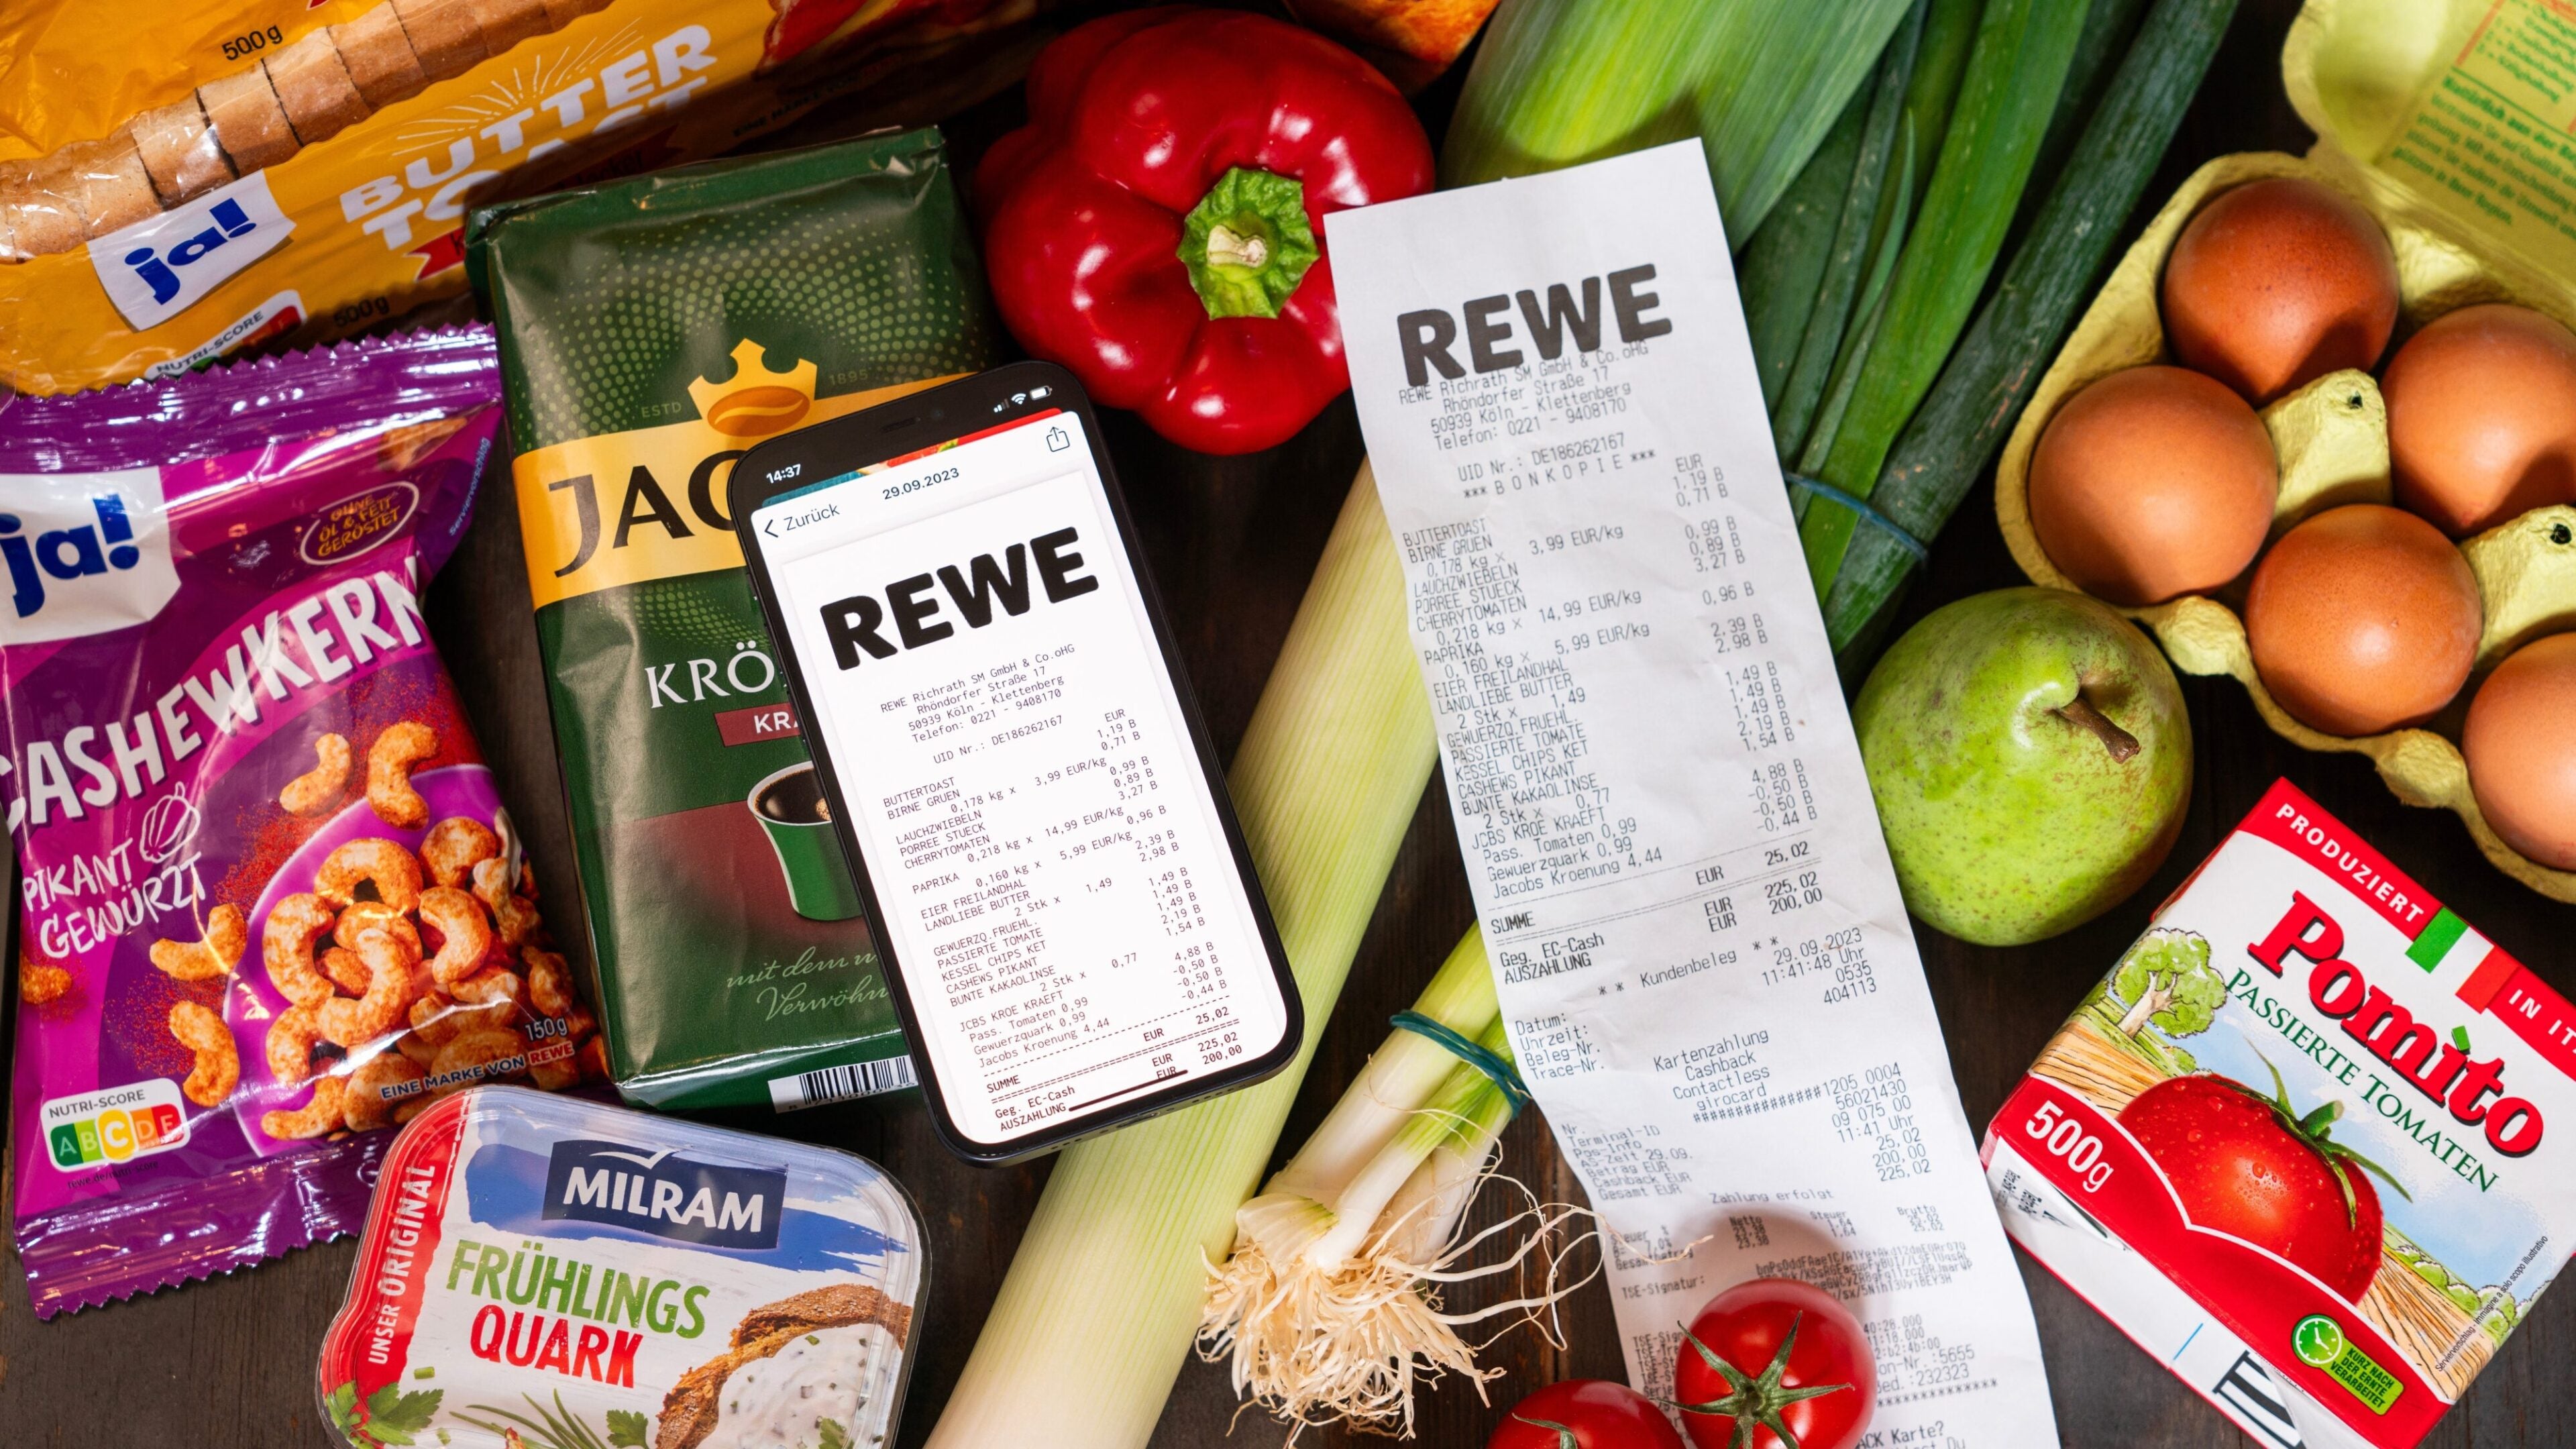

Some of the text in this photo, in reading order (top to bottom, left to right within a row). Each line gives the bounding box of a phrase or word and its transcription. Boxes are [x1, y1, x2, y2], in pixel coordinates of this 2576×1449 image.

[339, 24, 718, 223] BUTTER
[125, 198, 256, 305] ja!
[156, 310, 264, 372] NUTRI-SCORE
[1397, 263, 1673, 388] REWE
[828, 368, 869, 387] 1895
[1440, 372, 1507, 396] Richrath
[1443, 373, 1584, 413] Rhöndorfer Straße
[641, 401, 682, 419] ESTD
[1431, 382, 1631, 433] 50939 Klettenberg
[1434, 397, 1626, 450] Telefon: 9408170
[1531, 432, 1623, 465] DE186262167
[766, 464, 802, 484] 14:37
[881, 468, 961, 500] 29.09.2023
[318, 506, 400, 557] GERÖSTET
[319, 525, 339, 543] ÖL
[359, 493, 398, 521] FETT
[784, 503, 841, 532] Zurück
[0, 494, 140, 619] ja!
[820, 526, 1099, 672] REWE
[1589, 590, 1641, 612] EUR/kg
[645, 640, 787, 708] KRÖ
[880, 643, 1075, 712] REWE Richrath SM GmbH Co.oHG
[916, 674, 1026, 714] Rhöndorfer Straße
[1473, 657, 1568, 690] FREILANDHAL
[753, 711, 798, 734] KR
[908, 676, 1064, 731] 50939 Köln Klettenberg
[912, 688, 1061, 743] Telefon: 0221 9408170
[1104, 708, 1126, 722] EUR
[933, 751, 953, 763] UID
[991, 714, 1061, 745] DE186262167
[1450, 722, 1586, 765] PASSIERTE TOMATE
[883, 723, 1122, 807] BUTTERTOAST 1,19
[1454, 748, 1555, 782] KESSEL CHIPS
[888, 789, 960, 819] BIRNE GRUEN
[896, 760, 1135, 845] LAUCHZWIEBELN 0,99
[1553, 806, 1604, 831] KRAEFT
[900, 822, 985, 857] PORREE STUECK
[904, 835, 990, 869] CHERRYTOMATEN
[1534, 831, 1594, 853] Tomaten
[23, 837, 133, 912] PIKANT
[912, 872, 960, 894] PAPRIKA
[1491, 841, 1810, 934] SUMME EUR 25,02
[1494, 861, 1620, 899] Jacobs Kroenung
[40, 851, 206, 958] GEWÜRZT
[920, 879, 1026, 919] EIER FREILANDHAL
[924, 890, 1030, 931] LANDLIEBE BUTTER
[1542, 871, 1818, 959] EC-Cash EUR 225,02
[937, 927, 1042, 969] PASSIERTE TOMATE
[1505, 888, 1822, 985] AUSZAHLUNG 200,00
[2275, 804, 2576, 1055] PRODUZIERT IN IT
[727, 959, 781, 987] mit
[783, 946, 849, 977] dem
[946, 957, 1037, 994] CASHEWS PIKANT
[1515, 927, 1862, 1036] Datum: 29.09.2023
[1640, 950, 1736, 987] Kundenbeleg
[1519, 953, 1831, 1051] Uhrzeit: 11:41:48
[1525, 959, 1872, 1067] Beleg-Nr. 0535
[2247, 890, 2544, 1158] Pomito
[974, 1022, 1053, 1055] Gewuerzquark
[986, 1006, 1229, 1093] SUMME EUR 25,02
[1530, 977, 1876, 1079] Trace-Nr. 404113
[1653, 1030, 1768, 1071] Kartenzahlung
[381, 1041, 575, 1099] EINE MARKE VON REWE
[1028, 1032, 1238, 1108] EC-Cash 225,02
[1672, 1067, 1770, 1099] Contactless
[1685, 1049, 1756, 1081] Cashback
[2227, 967, 2500, 1193] PASSIERTE TOMATEN
[49, 1089, 145, 1118] NUTRI-SCORE
[1001, 1044, 1242, 1132] AUSZAHLUNG 200,00
[1697, 1081, 1766, 1111] girocard
[1835, 1079, 1906, 1110] 56021430
[2025, 1101, 2114, 1193] 500g
[564, 1166, 764, 1234] MILRAM
[1709, 1189, 1833, 1203] Zahlung erfolgt
[368, 1163, 435, 1365] UNSER ORIGINAL
[446, 1240, 710, 1339] FRÜHLINGS
[1621, 1276, 1705, 1299] TSE-Signatur:
[2436, 1326, 2476, 1372] Serviervorschlag
[2474, 1295, 2499, 1325] Immagine
[2510, 1263, 2526, 1281] scopo
[2521, 1235, 2548, 1265] illustrativo
[470, 1303, 643, 1389] QUARK
[2347, 1348, 2395, 1389] KURZ NACH
[2330, 1360, 2386, 1408] VERARBEITET
[2341, 1356, 2387, 1397] DER ERNTE
[1890, 1420, 1944, 1444] Karte?
